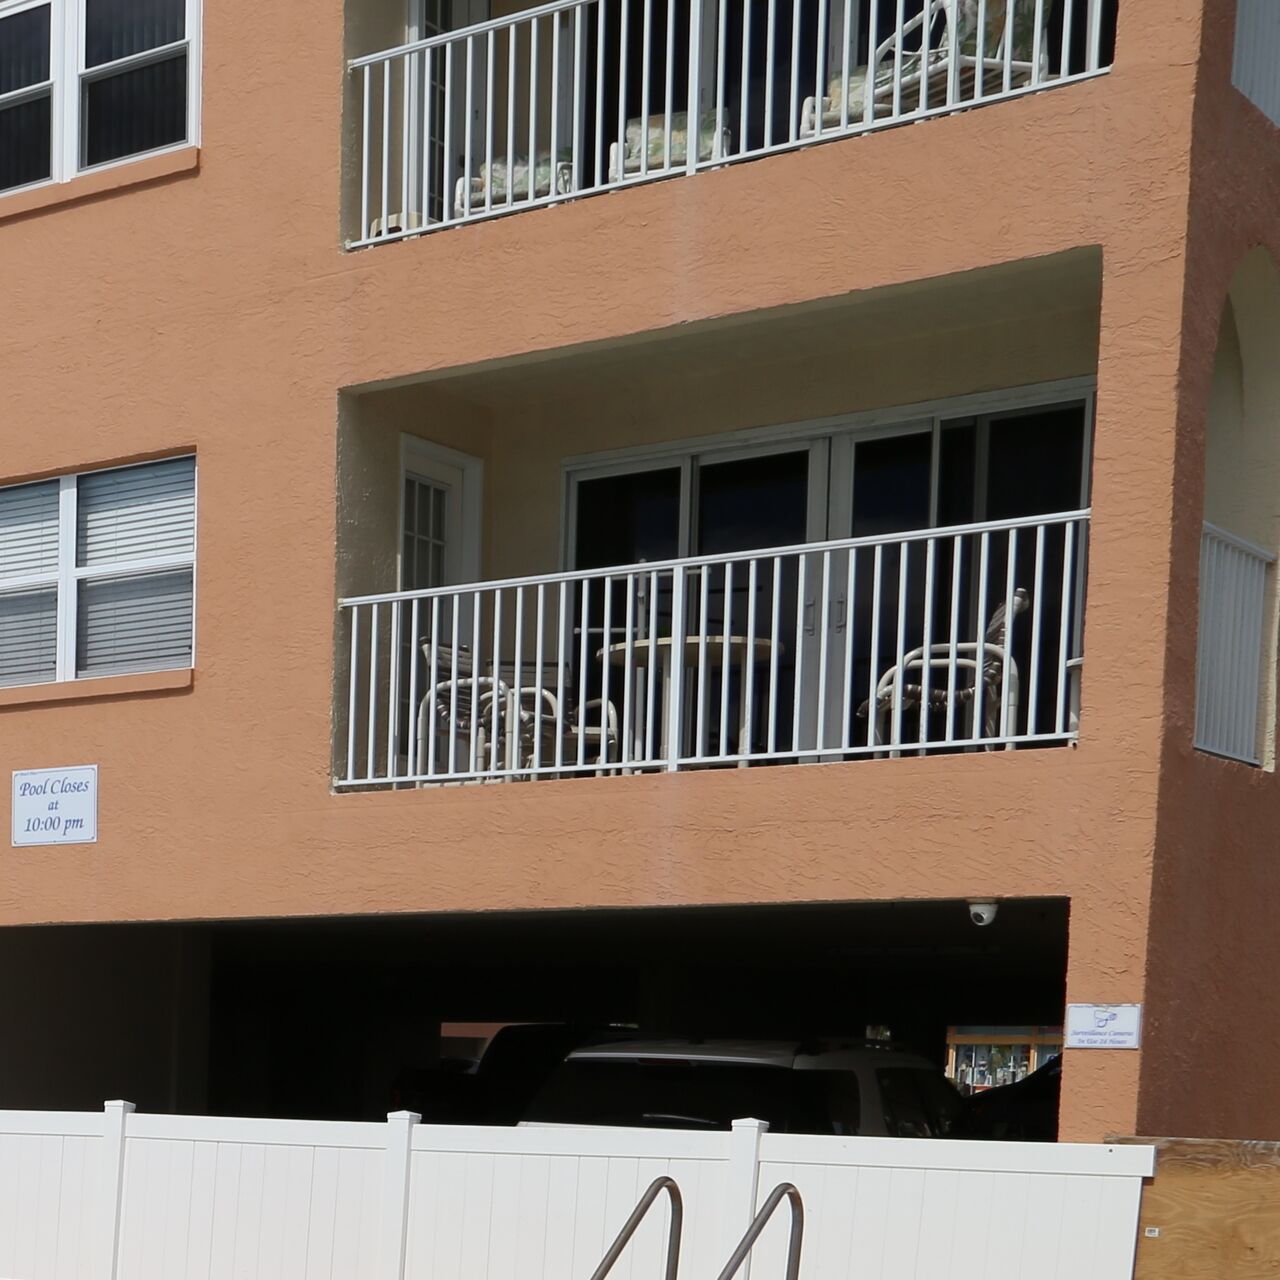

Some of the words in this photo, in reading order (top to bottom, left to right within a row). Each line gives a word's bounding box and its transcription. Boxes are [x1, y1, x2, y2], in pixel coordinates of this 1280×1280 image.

[19, 778, 50, 797] Pool
[50, 776, 90, 795] Closes
[47, 800, 59, 811] at
[24, 816, 61, 832] 10:00
[62, 818, 84, 836] pm
